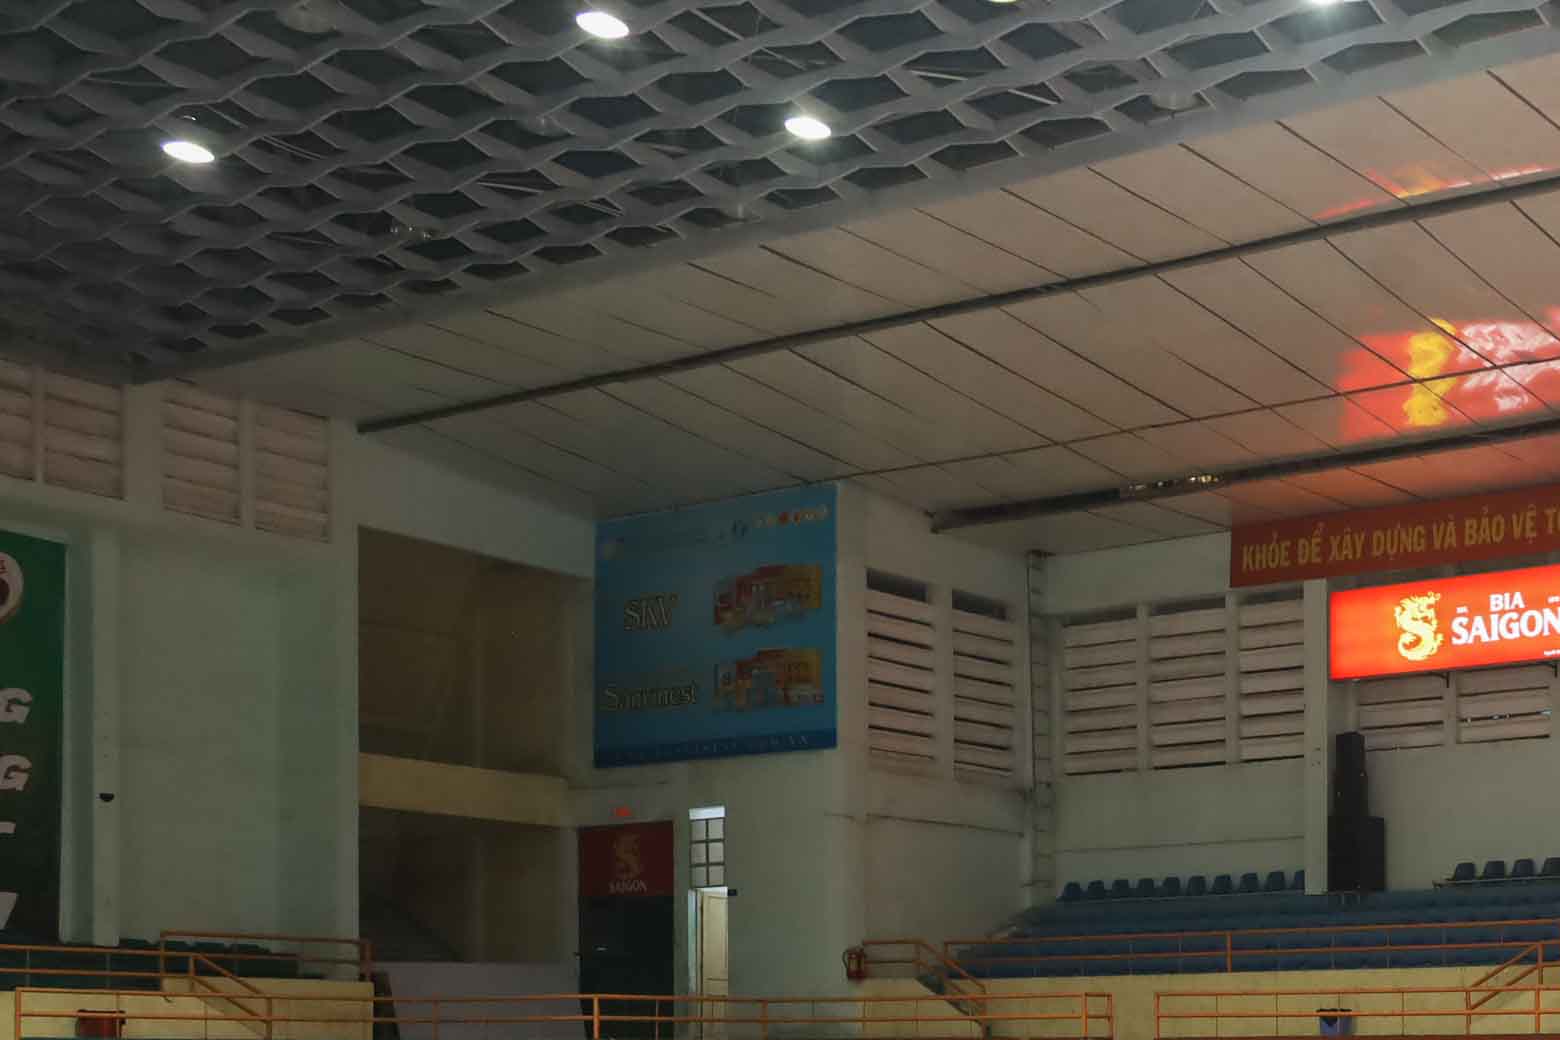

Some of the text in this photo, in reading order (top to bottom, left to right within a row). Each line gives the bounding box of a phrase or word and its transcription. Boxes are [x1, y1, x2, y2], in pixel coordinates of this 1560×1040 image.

[1242, 532, 1289, 573] KHỎE
[1297, 522, 1324, 564] ĐỂ
[1329, 530, 1366, 562] XÂY
[1373, 525, 1425, 561] DỰNG
[1433, 521, 1456, 551] VÀ
[1464, 506, 1505, 546] BẢO
[1512, 502, 1536, 545] VỆ
[1488, 591, 1525, 612] BIA
